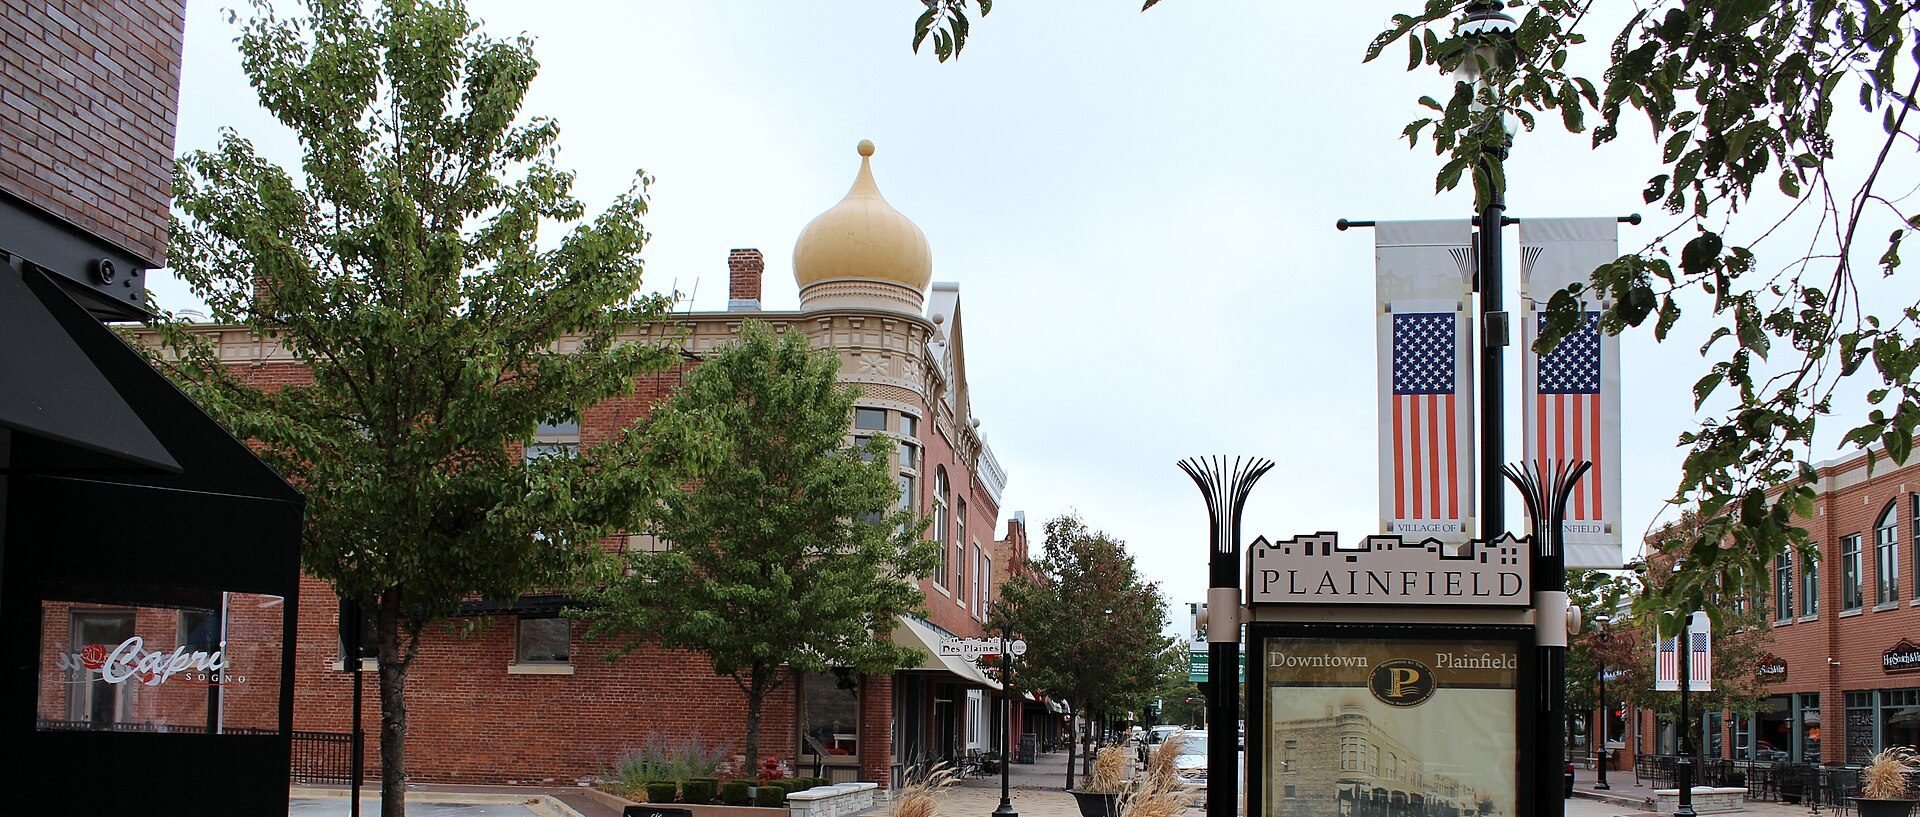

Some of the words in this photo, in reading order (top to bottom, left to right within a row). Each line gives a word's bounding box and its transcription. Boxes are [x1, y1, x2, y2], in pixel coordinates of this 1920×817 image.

[1398, 524, 1440, 532] VILLAGE
[1442, 523, 1456, 532] OF
[1260, 569, 1523, 597] PLAINFIELD
[942, 645, 961, 653] Des
[964, 644, 999, 653] Plaines
[102, 636, 226, 685] Capri
[1270, 651, 1368, 668] Downtown
[1435, 652, 1518, 669] Plainfield
[185, 672, 246, 684] SOGNO
